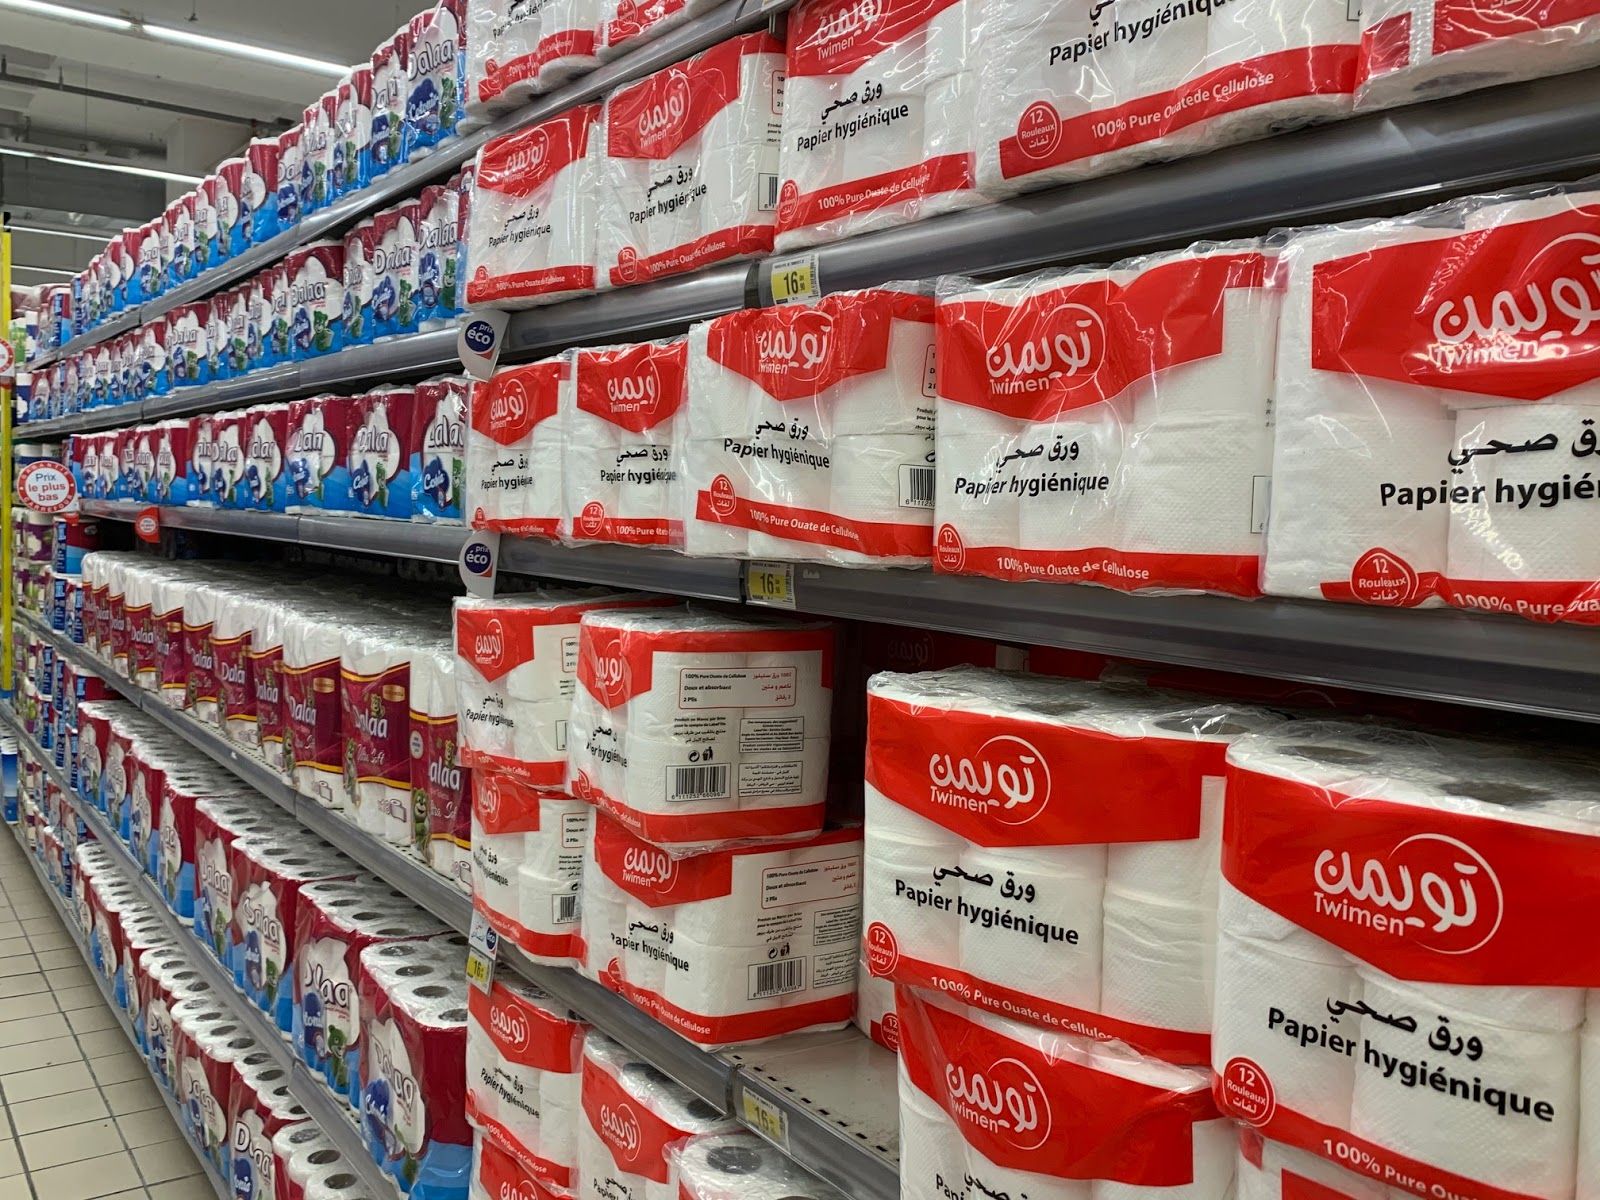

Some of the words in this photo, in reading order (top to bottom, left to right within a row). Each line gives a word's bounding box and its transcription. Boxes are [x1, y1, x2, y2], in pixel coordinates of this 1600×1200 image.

[817, 37, 854, 60] Twimen
[1050, 29, 1110, 65] Papier
[821, 93, 858, 124] صحي
[1091, 119, 1127, 139] 100%
[1129, 112, 1161, 129] Pure
[1213, 71, 1274, 98] Cellulose
[797, 127, 833, 151] Papier
[835, 102, 909, 140] hygiénique
[1029, 110, 1044, 125] 12
[640, 131, 668, 148] Twimen
[1021, 123, 1055, 140] Rouleaux
[818, 195, 844, 210] 100%
[845, 191, 864, 203] Pure
[629, 204, 656, 224] Papier
[488, 229, 508, 247] Papier
[509, 224, 551, 246] hygiénique
[784, 271, 798, 297] 16
[466, 326, 490, 345] éco
[479, 322, 494, 334] prix
[986, 319, 1092, 379] تويمن
[1434, 339, 1540, 367] Twimen
[990, 376, 1050, 395] Twimen
[755, 420, 785, 439] صحي
[724, 438, 769, 459] Papier
[772, 447, 830, 468] hygiénique
[1047, 435, 1079, 461] ورق
[1447, 432, 1559, 474] صحي
[28, 484, 38, 492] le
[41, 483, 66, 494] plus
[35, 473, 56, 483] Prix
[481, 476, 498, 490] Papier
[600, 470, 626, 484] Papier
[719, 480, 728, 491] 12
[955, 476, 1008, 498] Papier
[1009, 472, 1109, 498] hygiénique
[38, 493, 58, 502] bas
[1380, 480, 1485, 510] Papier
[636, 526, 655, 536] Pure
[750, 509, 769, 523] 100%
[770, 515, 789, 527] Pure
[790, 518, 818, 532] Ouate
[820, 522, 830, 533] de
[476, 545, 490, 553] prix
[944, 531, 953, 543] 12
[467, 548, 488, 565] éco
[996, 556, 1023, 573] 100%
[1023, 563, 1046, 575] Pure
[1047, 564, 1080, 576] Ouate
[1082, 561, 1100, 572] de
[1102, 559, 1149, 580] Cellulose
[1372, 558, 1388, 574] 12
[760, 573, 775, 595] 16
[1358, 576, 1407, 589] Rouleaux
[1453, 592, 1513, 613] 100%
[1516, 598, 1564, 616] Pure
[466, 708, 487, 723] Papier
[929, 753, 1036, 809] تويمن
[930, 786, 988, 814] Twimen
[622, 870, 652, 887] Twimen
[933, 865, 994, 887] صحي
[1000, 870, 1036, 903] ورق
[1315, 850, 1479, 933] تويمن
[895, 879, 952, 911] Papier
[957, 897, 1079, 945] hygiénique
[1314, 891, 1404, 936] Twimen
[628, 919, 658, 935] صحي
[874, 929, 886, 944] 12
[643, 941, 690, 972] hygiénique
[931, 975, 971, 998] 100%
[973, 989, 1000, 1008] Pure
[1002, 1000, 1040, 1021] Ouate
[1042, 1011, 1059, 1027] de
[632, 993, 651, 1008] 100%
[680, 1017, 711, 1035] Cellulose
[888, 1019, 897, 1029] 12
[1326, 997, 1418, 1033] صحي
[1428, 1014, 1483, 1061] ورق
[1268, 1007, 1357, 1057] Papier
[1364, 1040, 1555, 1122] hygiénique
[1239, 1067, 1256, 1087] 12
[480, 1067, 499, 1092] Papier
[498, 1082, 540, 1119] hygiénique
[945, 1062, 1037, 1134] تويمن
[1226, 1078, 1267, 1106] Rouleaux
[950, 1092, 1000, 1135] Twimen
[1232, 1095, 1258, 1116] لفات
[754, 1107, 768, 1131] 16
[1323, 1138, 1382, 1175] 100%
[1384, 1164, 1427, 1193] Pure
